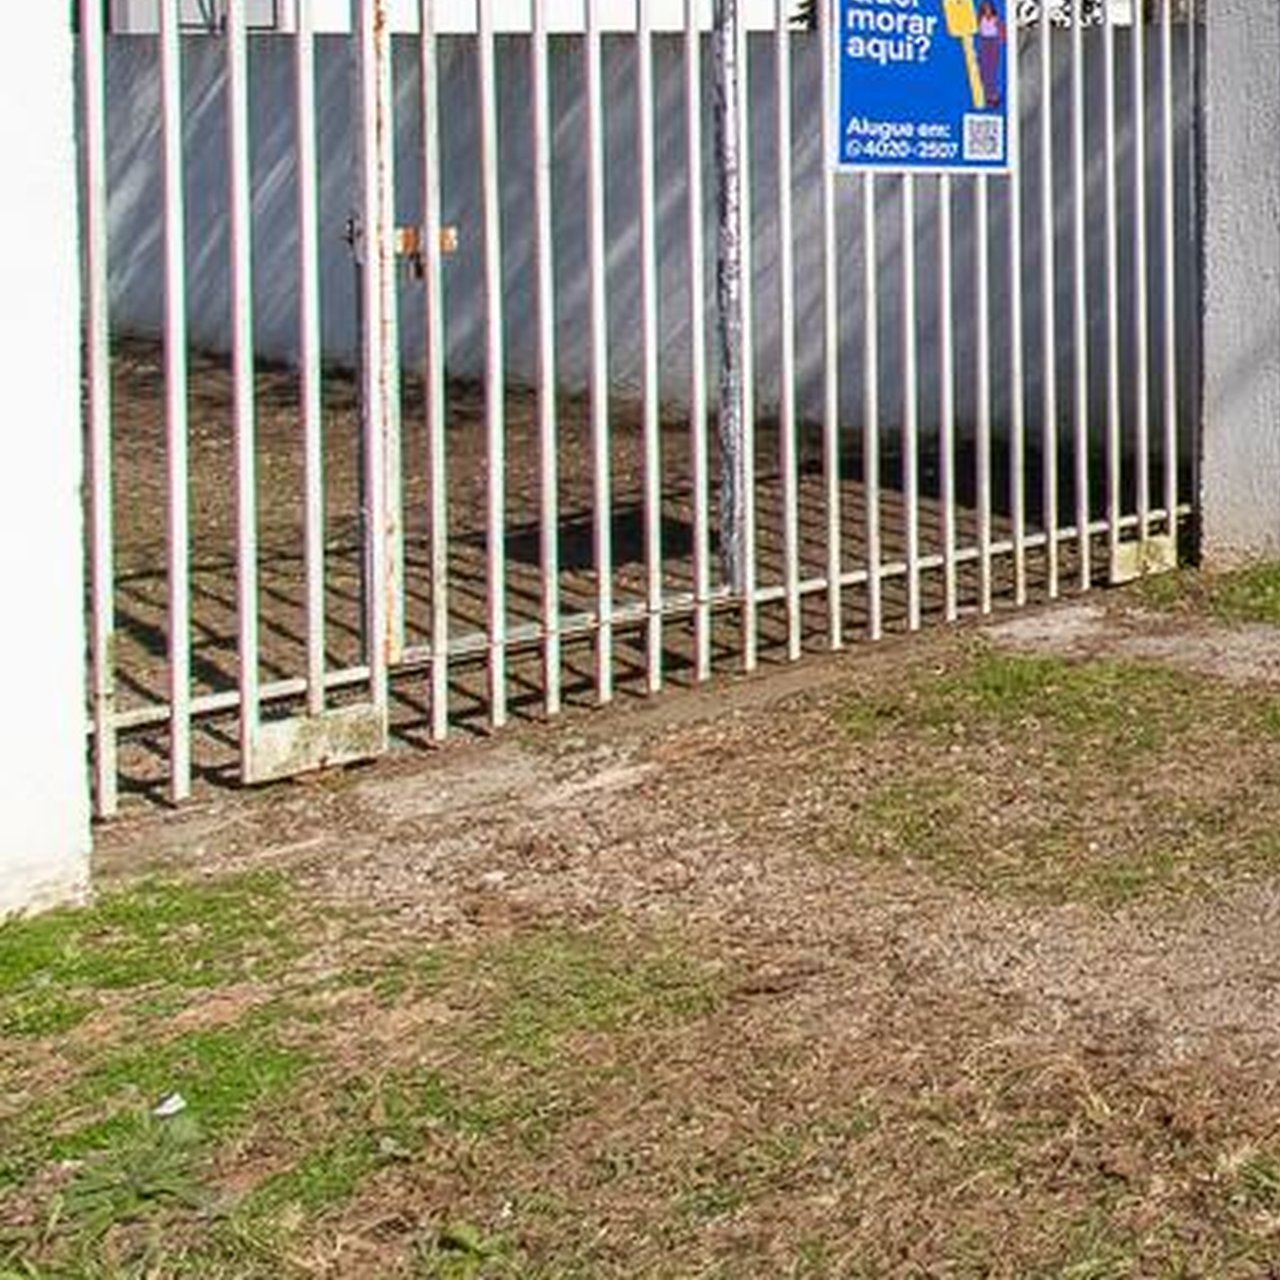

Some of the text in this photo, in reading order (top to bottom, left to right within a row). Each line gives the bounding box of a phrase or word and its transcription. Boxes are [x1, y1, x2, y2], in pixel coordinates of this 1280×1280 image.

[847, 8, 938, 36] morar
[846, 36, 931, 66] aqui?
[846, 116, 914, 140] Alugue
